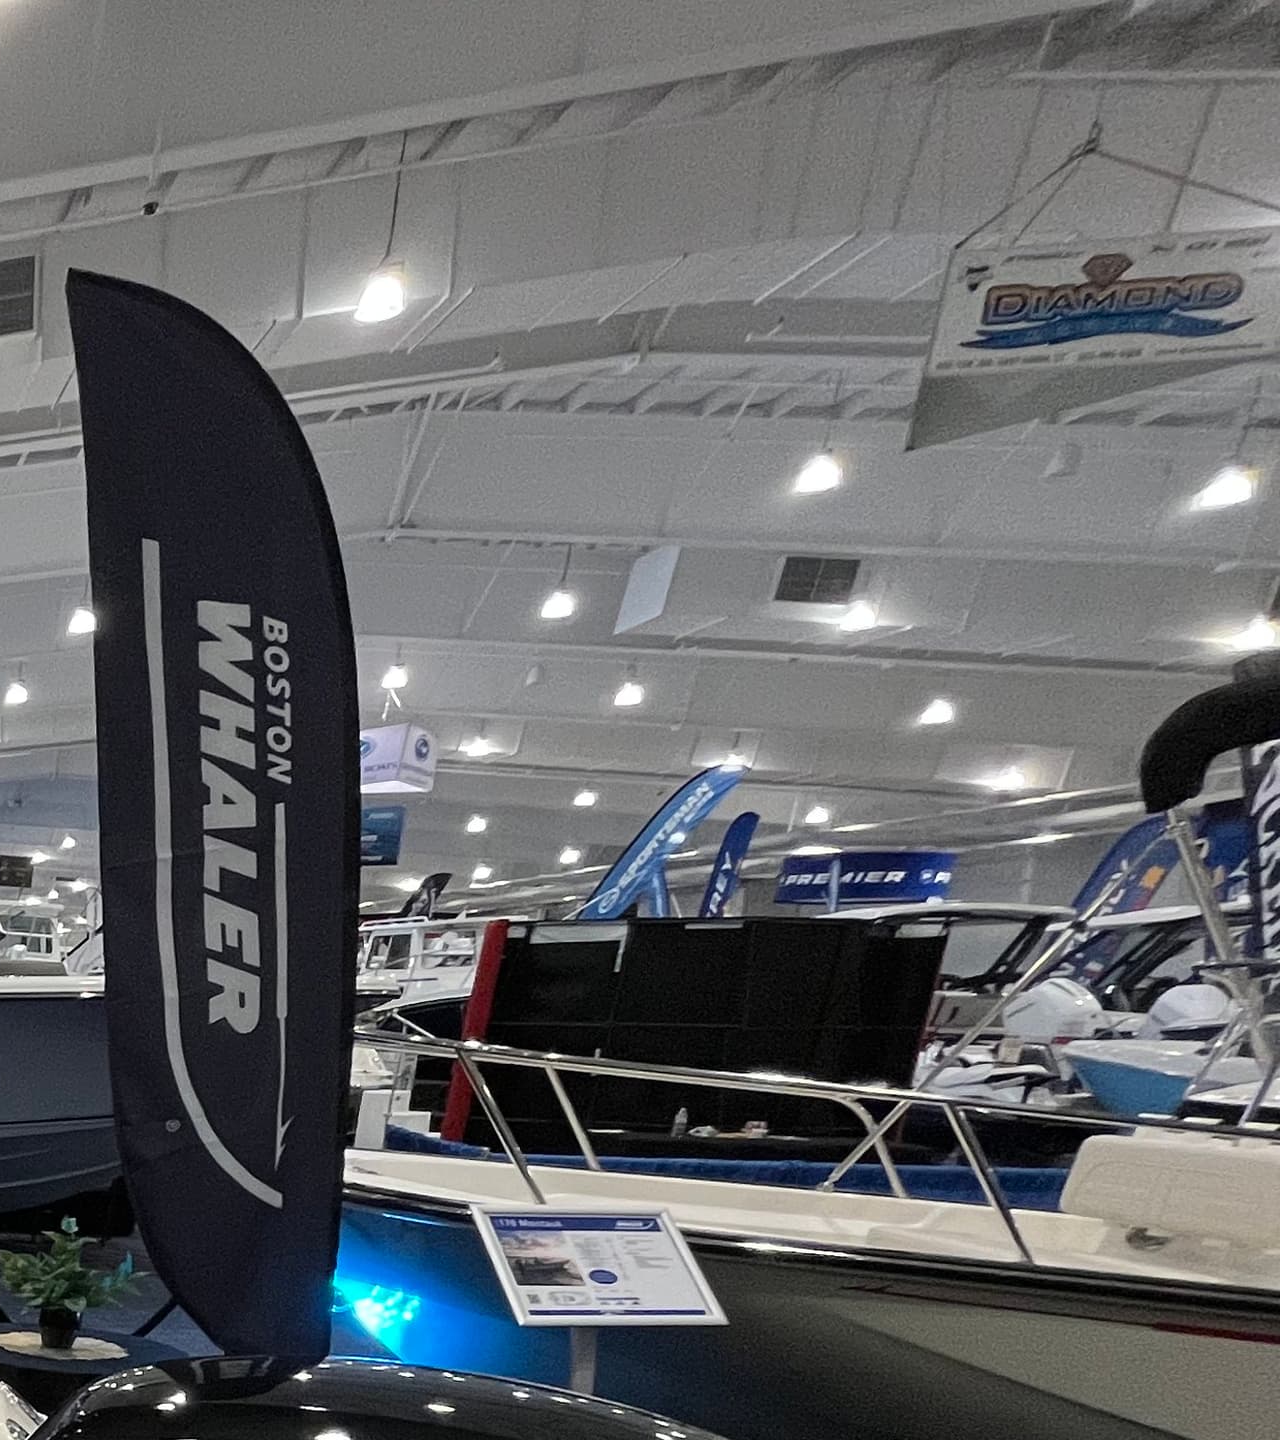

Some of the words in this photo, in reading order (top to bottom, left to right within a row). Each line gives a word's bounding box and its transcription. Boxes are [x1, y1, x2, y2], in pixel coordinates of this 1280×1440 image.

[981, 273, 1244, 325] DIAMOND
[261, 614, 292, 786] BOSTON
[195, 599, 264, 1036] WHALER
